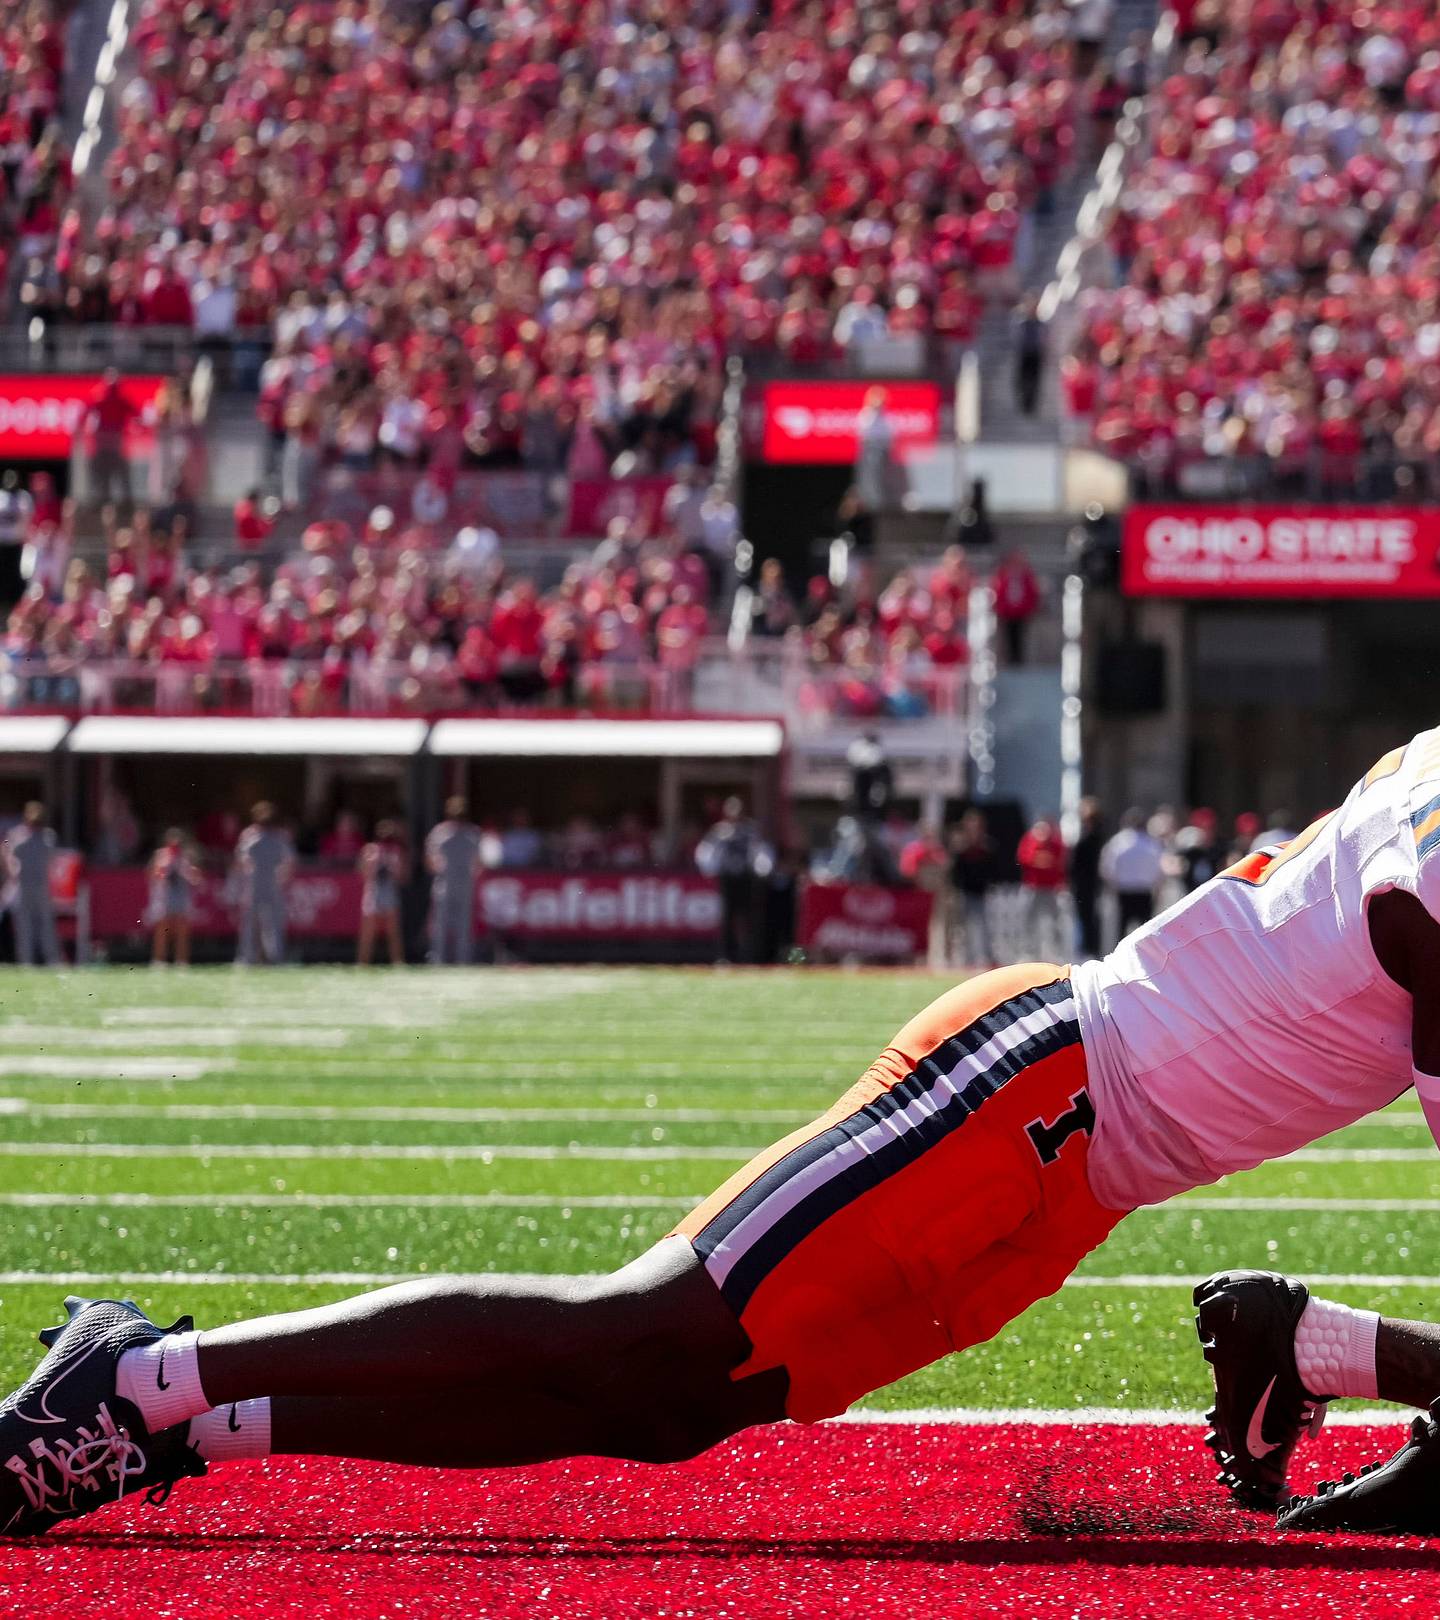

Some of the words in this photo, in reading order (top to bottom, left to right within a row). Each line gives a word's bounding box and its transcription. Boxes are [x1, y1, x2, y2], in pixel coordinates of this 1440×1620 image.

[1144, 516, 1264, 563] OHIO
[1266, 517, 1416, 564] STATE
[481, 877, 721, 928] Safelite
